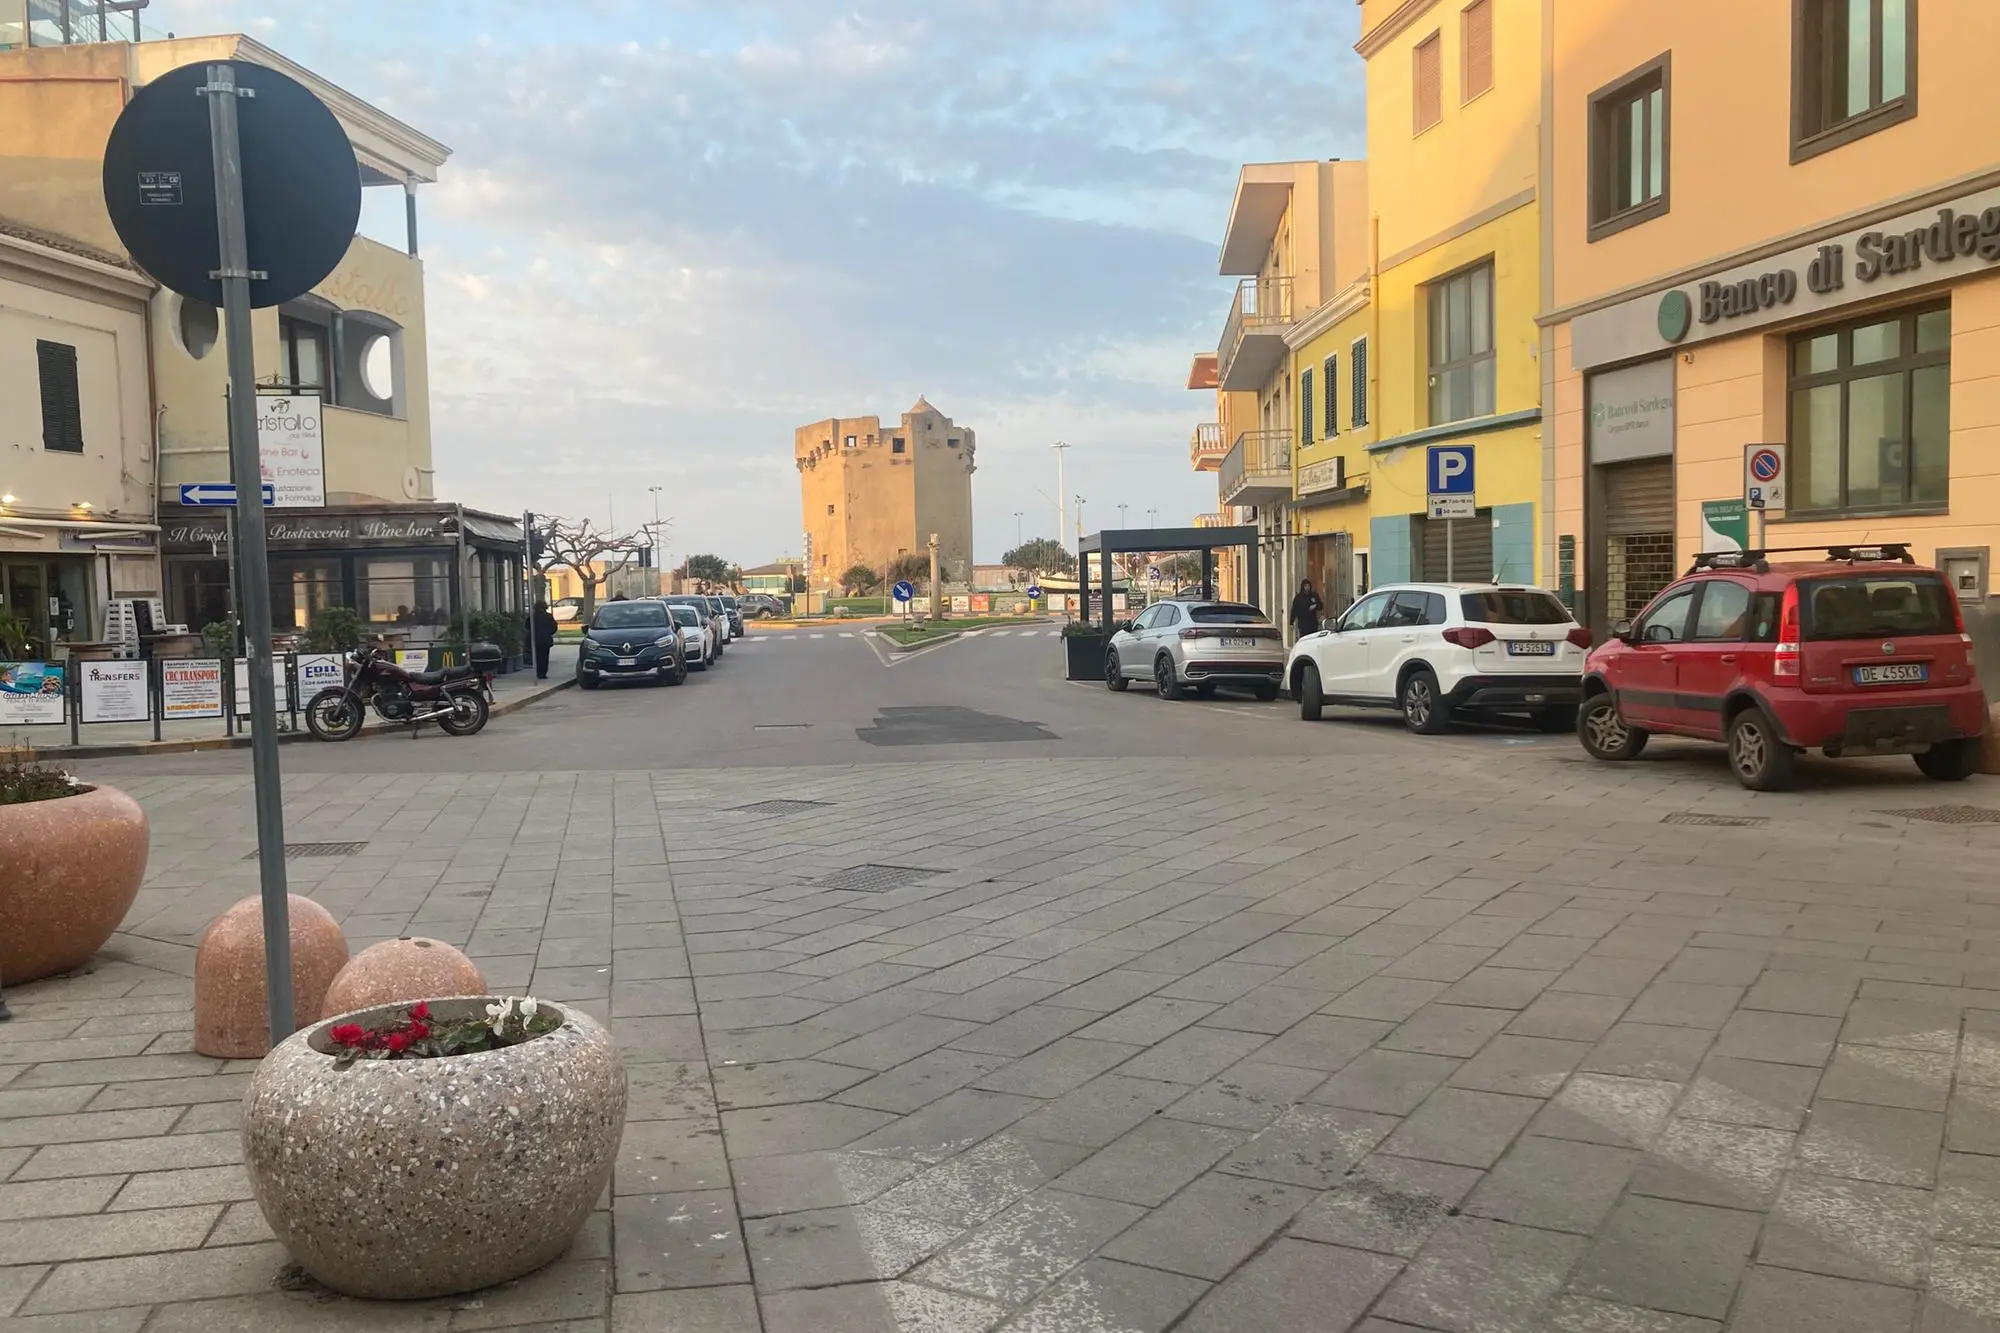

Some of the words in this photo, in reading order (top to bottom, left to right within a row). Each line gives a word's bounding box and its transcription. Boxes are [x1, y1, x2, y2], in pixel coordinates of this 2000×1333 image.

[1698, 268, 1798, 324] Banco
[1807, 244, 1845, 294] di
[258, 413, 317, 431] ristallo
[281, 447, 298, 457] Bar
[277, 466, 321, 476] Enoteca
[1438, 451, 1467, 489] P
[276, 484, 313, 493] ustazione
[1751, 488, 1760, 499] P
[168, 526, 188, 543] Il
[267, 522, 351, 540] Pasticceria
[364, 522, 403, 538] Wine
[89, 673, 140, 681] TRANSFERS
[180, 669, 219, 680] TRANSPORT
[1862, 666, 1878, 681] DE
[1882, 664, 1920, 680] 455KR
